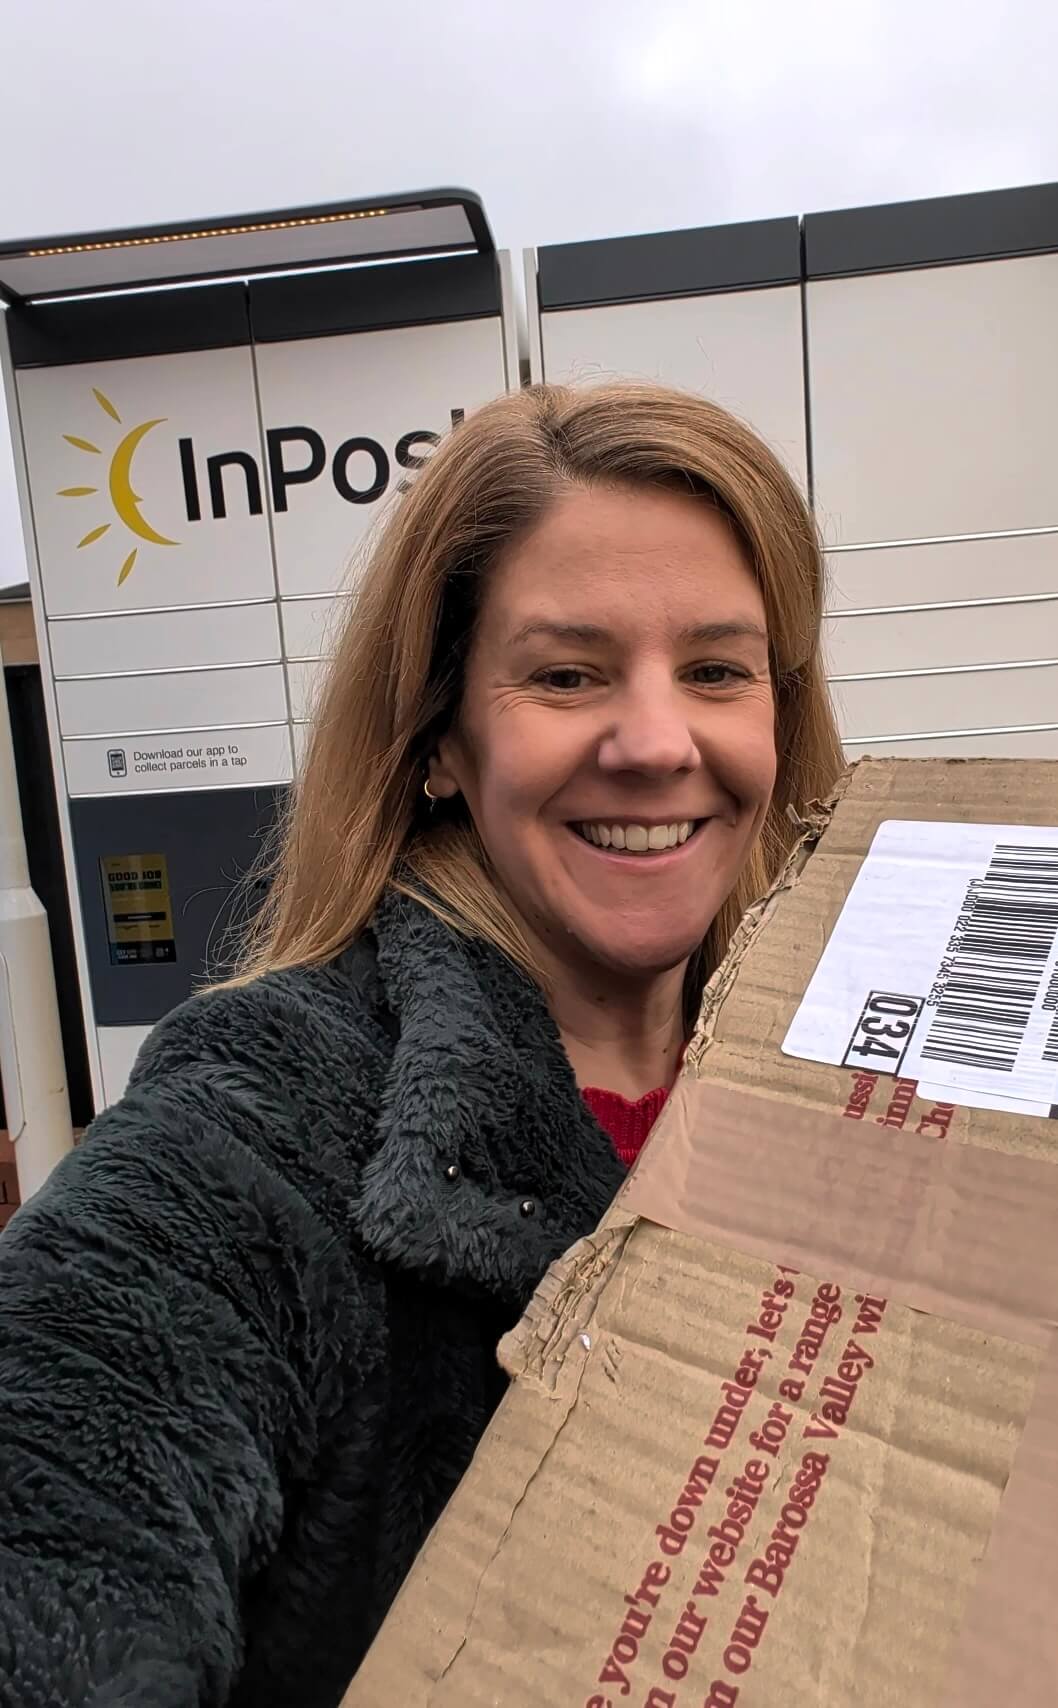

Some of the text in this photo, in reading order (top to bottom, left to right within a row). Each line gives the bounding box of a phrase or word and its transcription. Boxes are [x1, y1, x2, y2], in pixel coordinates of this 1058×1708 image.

[178, 408, 465, 521] InPos
[134, 745, 239, 761] Download our app to
[135, 756, 247, 773] collect parcels in a tap
[108, 869, 162, 882] GOOD JOB
[946, 935, 964, 953] 335
[954, 915, 971, 932] 022
[926, 982, 946, 1007] 3255
[936, 955, 956, 979] 7345
[852, 996, 918, 1059] 034
[876, 1076, 919, 1130] inni
[789, 1282, 842, 1376] range
[852, 1293, 888, 1336] wi
[599, 1560, 671, 1695] you're
[656, 1455, 721, 1556] down
[746, 1277, 795, 1343] let's
[843, 1071, 879, 1120] ussi
[779, 1378, 805, 1403] a
[803, 1339, 874, 1440] Valley
[750, 1402, 795, 1458] for
[692, 1458, 770, 1599] website
[745, 1452, 830, 1598] Barossa
[662, 1601, 708, 1681] our
[723, 1596, 769, 1675] our
